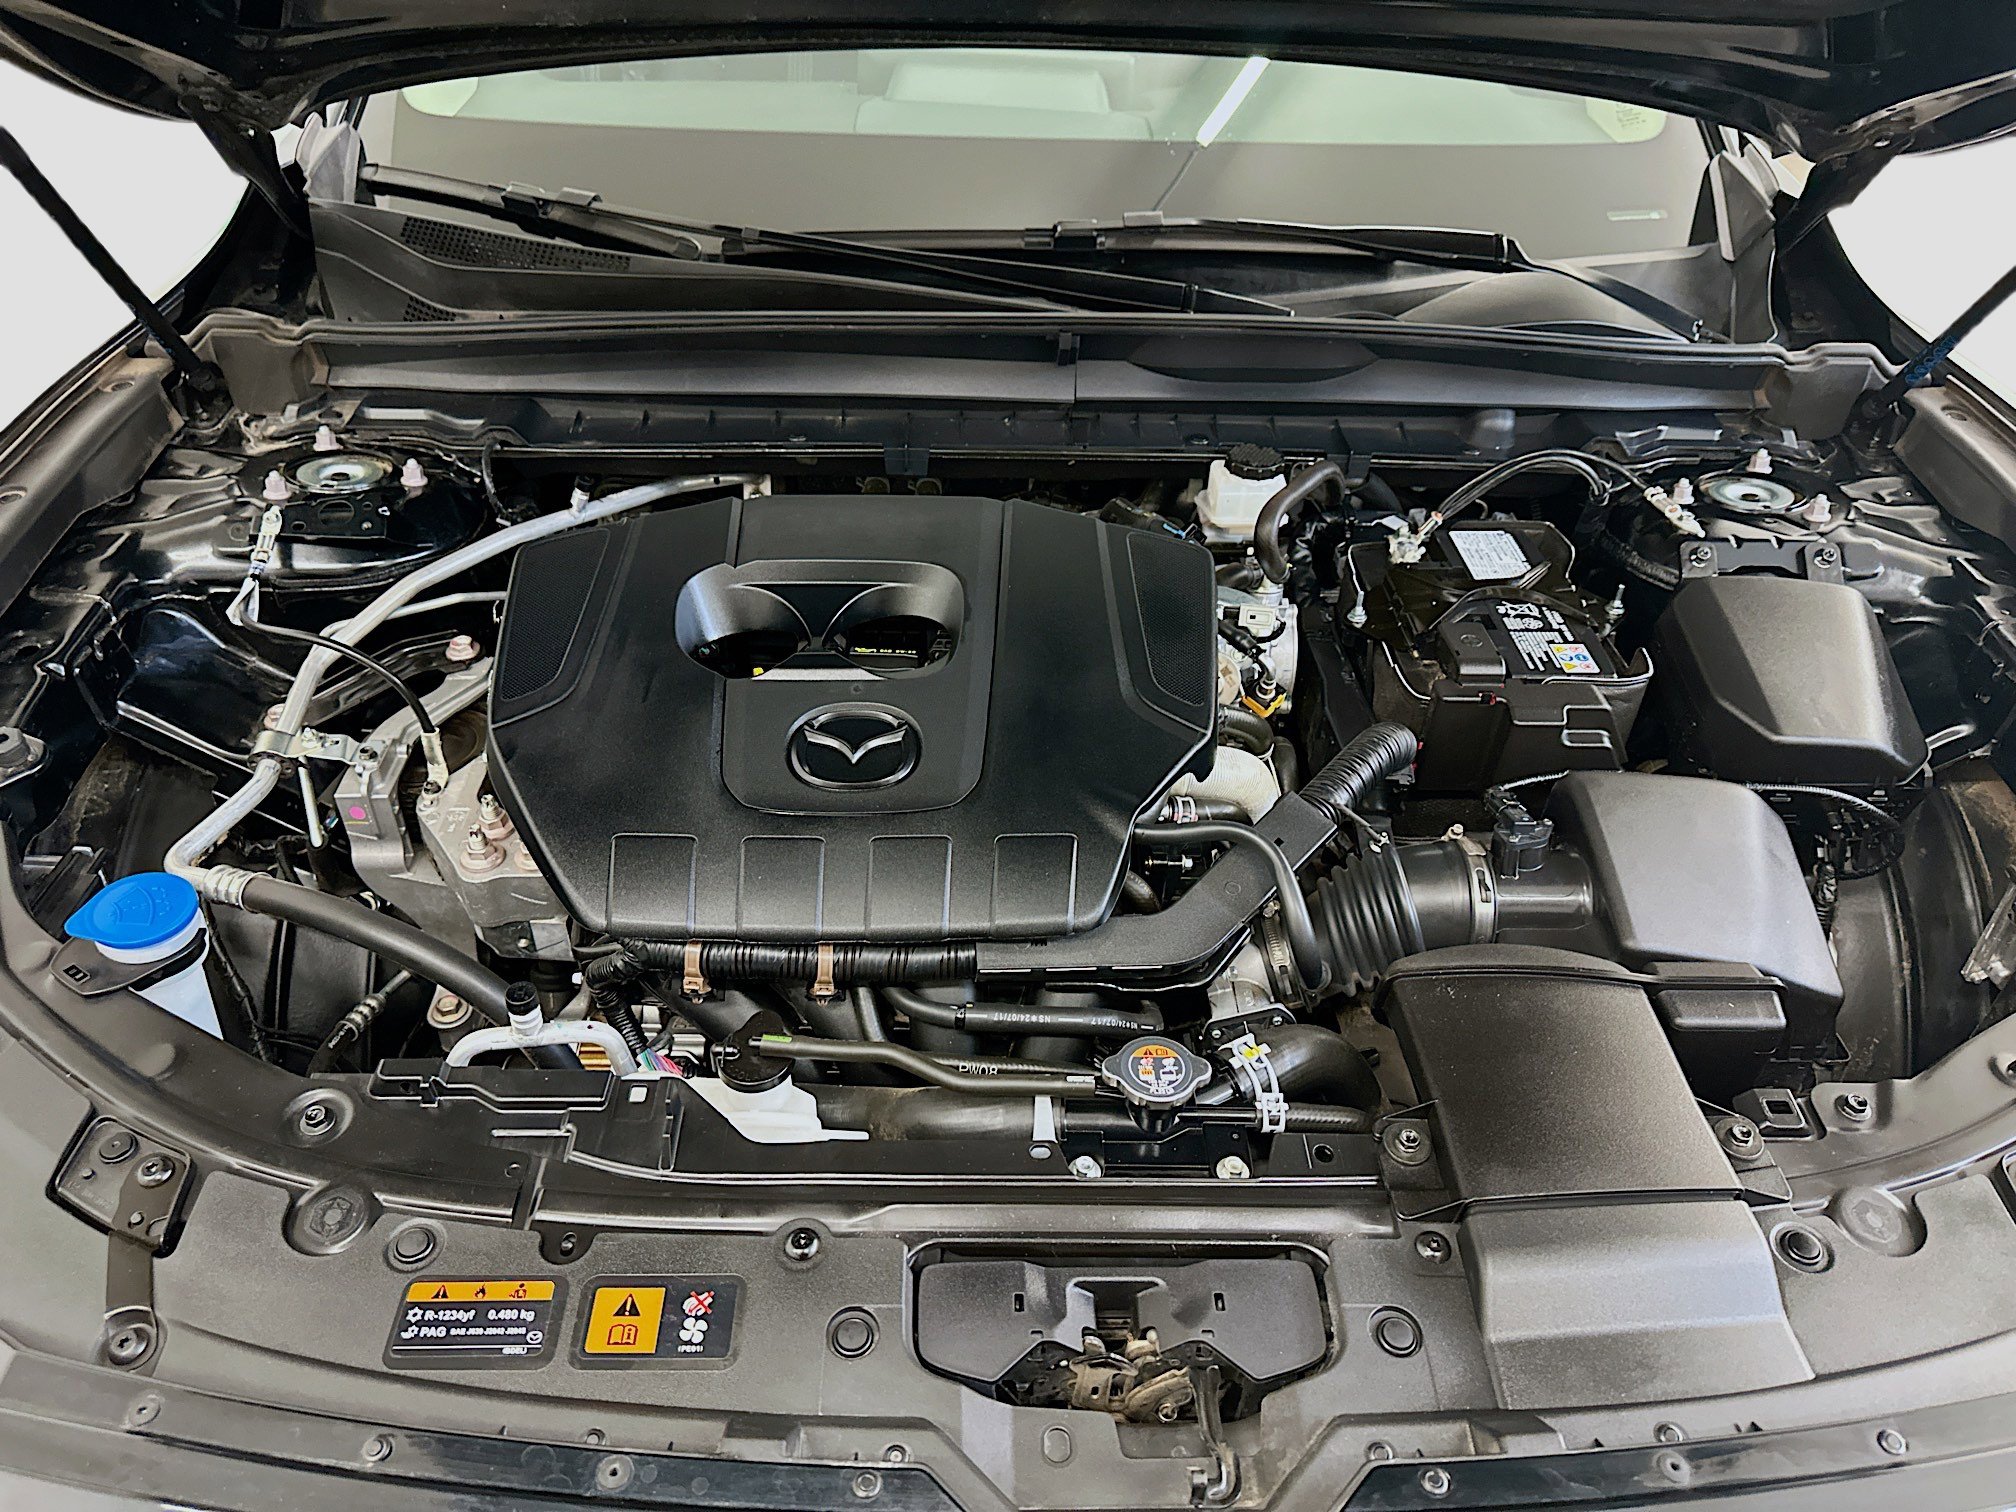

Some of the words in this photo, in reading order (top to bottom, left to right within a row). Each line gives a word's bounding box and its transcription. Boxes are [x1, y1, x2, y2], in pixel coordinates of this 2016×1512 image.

[424, 1309, 476, 1322] R-1234yf
[487, 1308, 519, 1320] 0.480
[520, 1308, 536, 1322] kg
[419, 1326, 447, 1338] PAG
